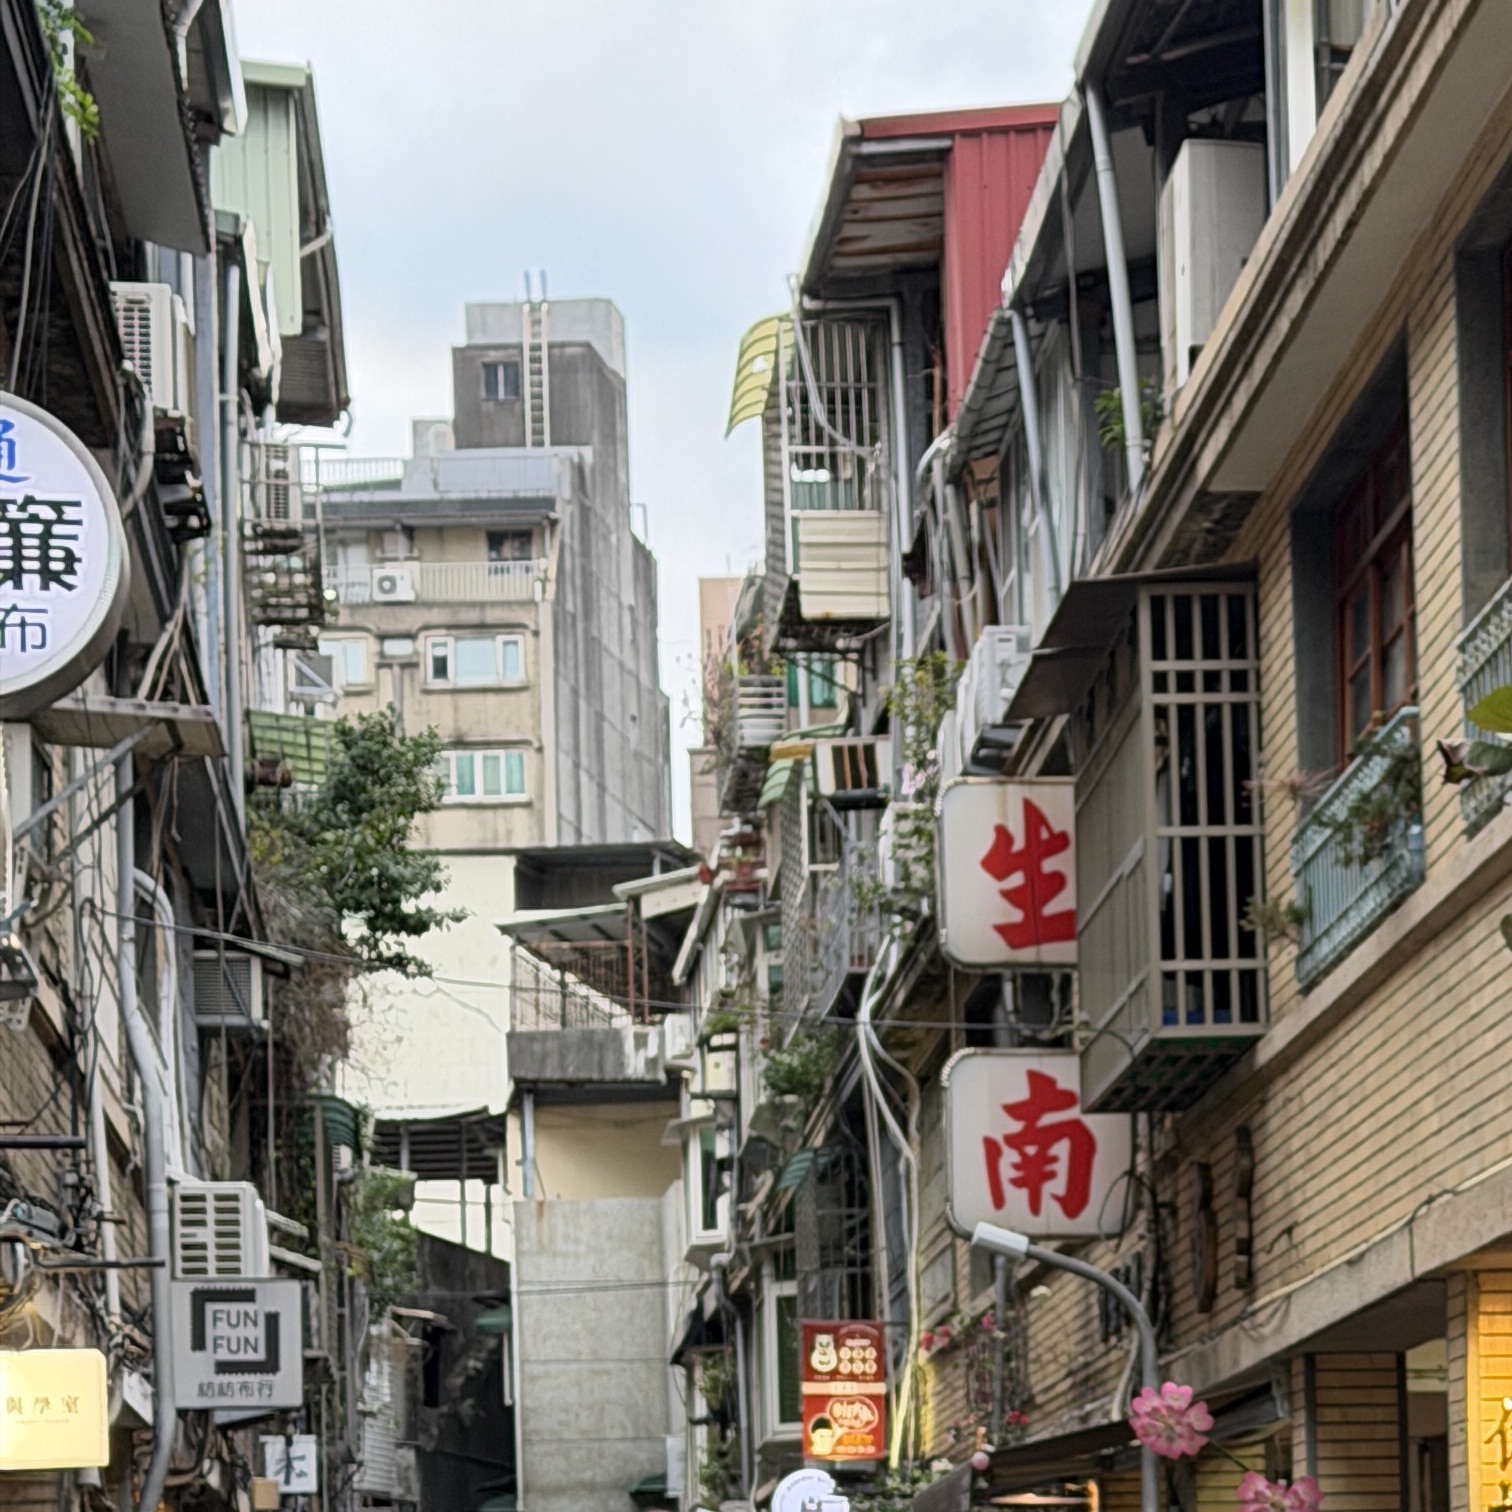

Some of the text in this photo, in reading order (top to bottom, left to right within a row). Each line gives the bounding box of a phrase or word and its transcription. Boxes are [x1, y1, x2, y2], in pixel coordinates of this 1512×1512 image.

[982, 1069, 1097, 1220] 南
[212, 1308, 259, 1329] FUN
[212, 1336, 259, 1355] FUN
